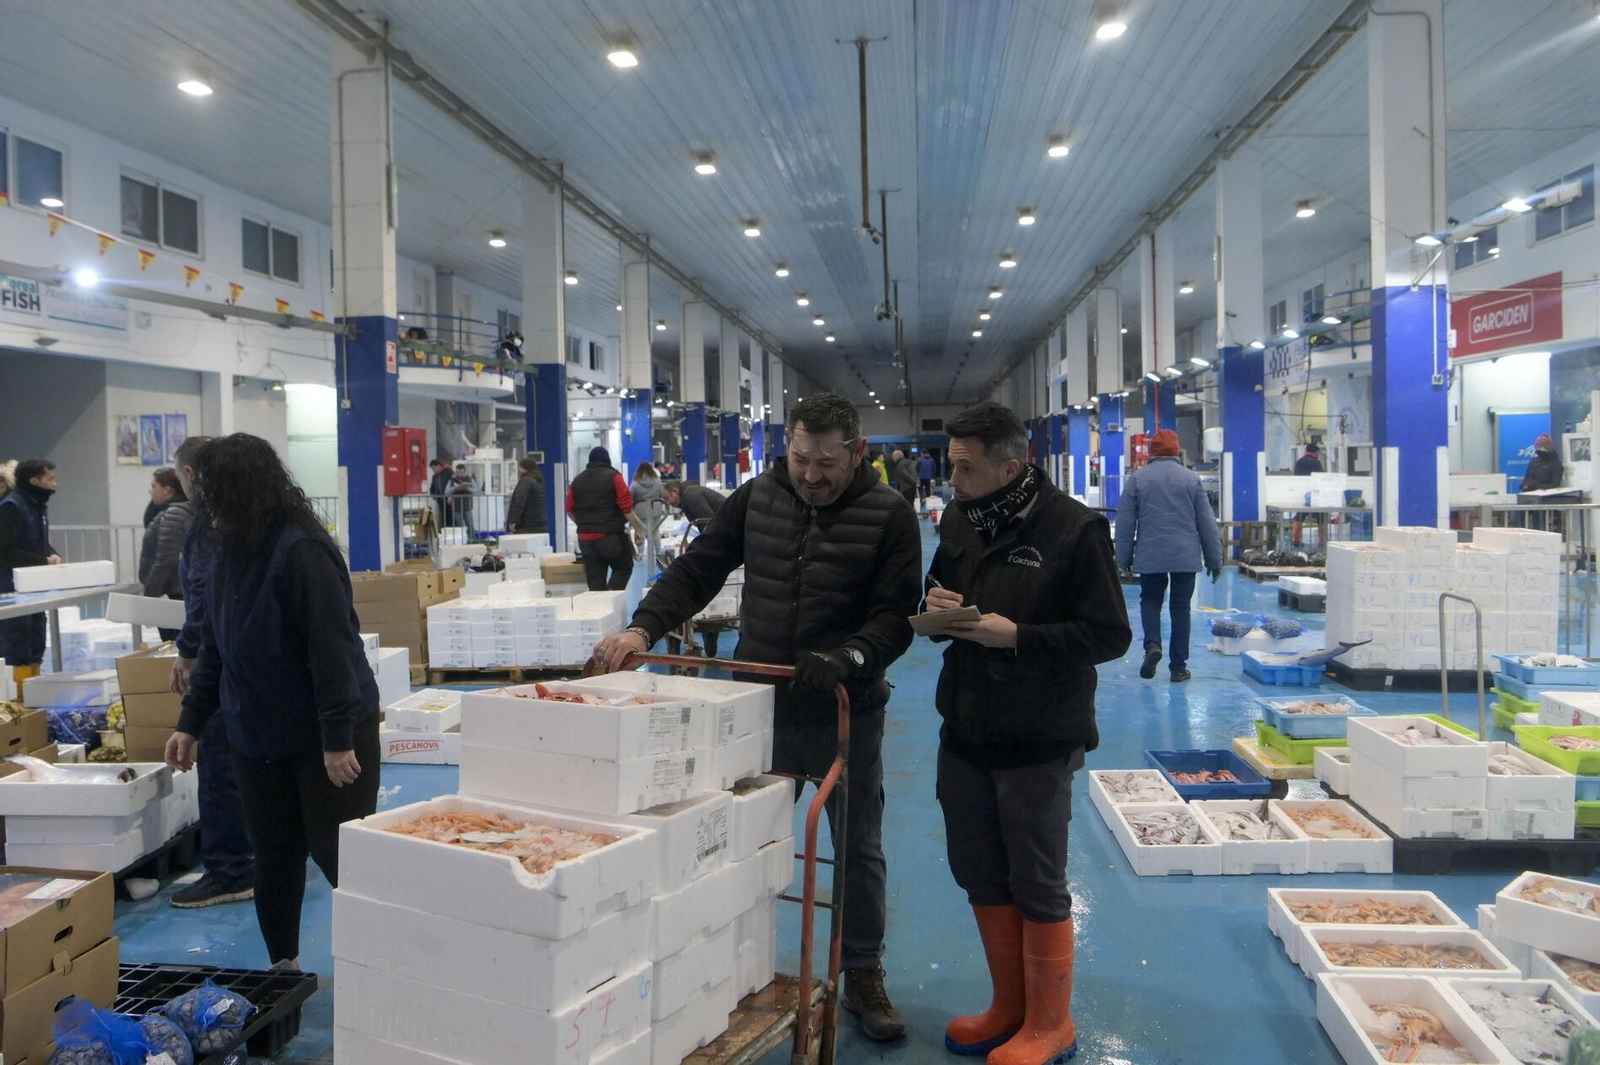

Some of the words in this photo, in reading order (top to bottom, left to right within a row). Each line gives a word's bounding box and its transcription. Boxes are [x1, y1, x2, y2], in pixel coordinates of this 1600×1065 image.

[2, 289, 41, 312] FISH
[1473, 303, 1529, 334] GARCIDEN
[389, 742, 440, 753] PESCANOVA
